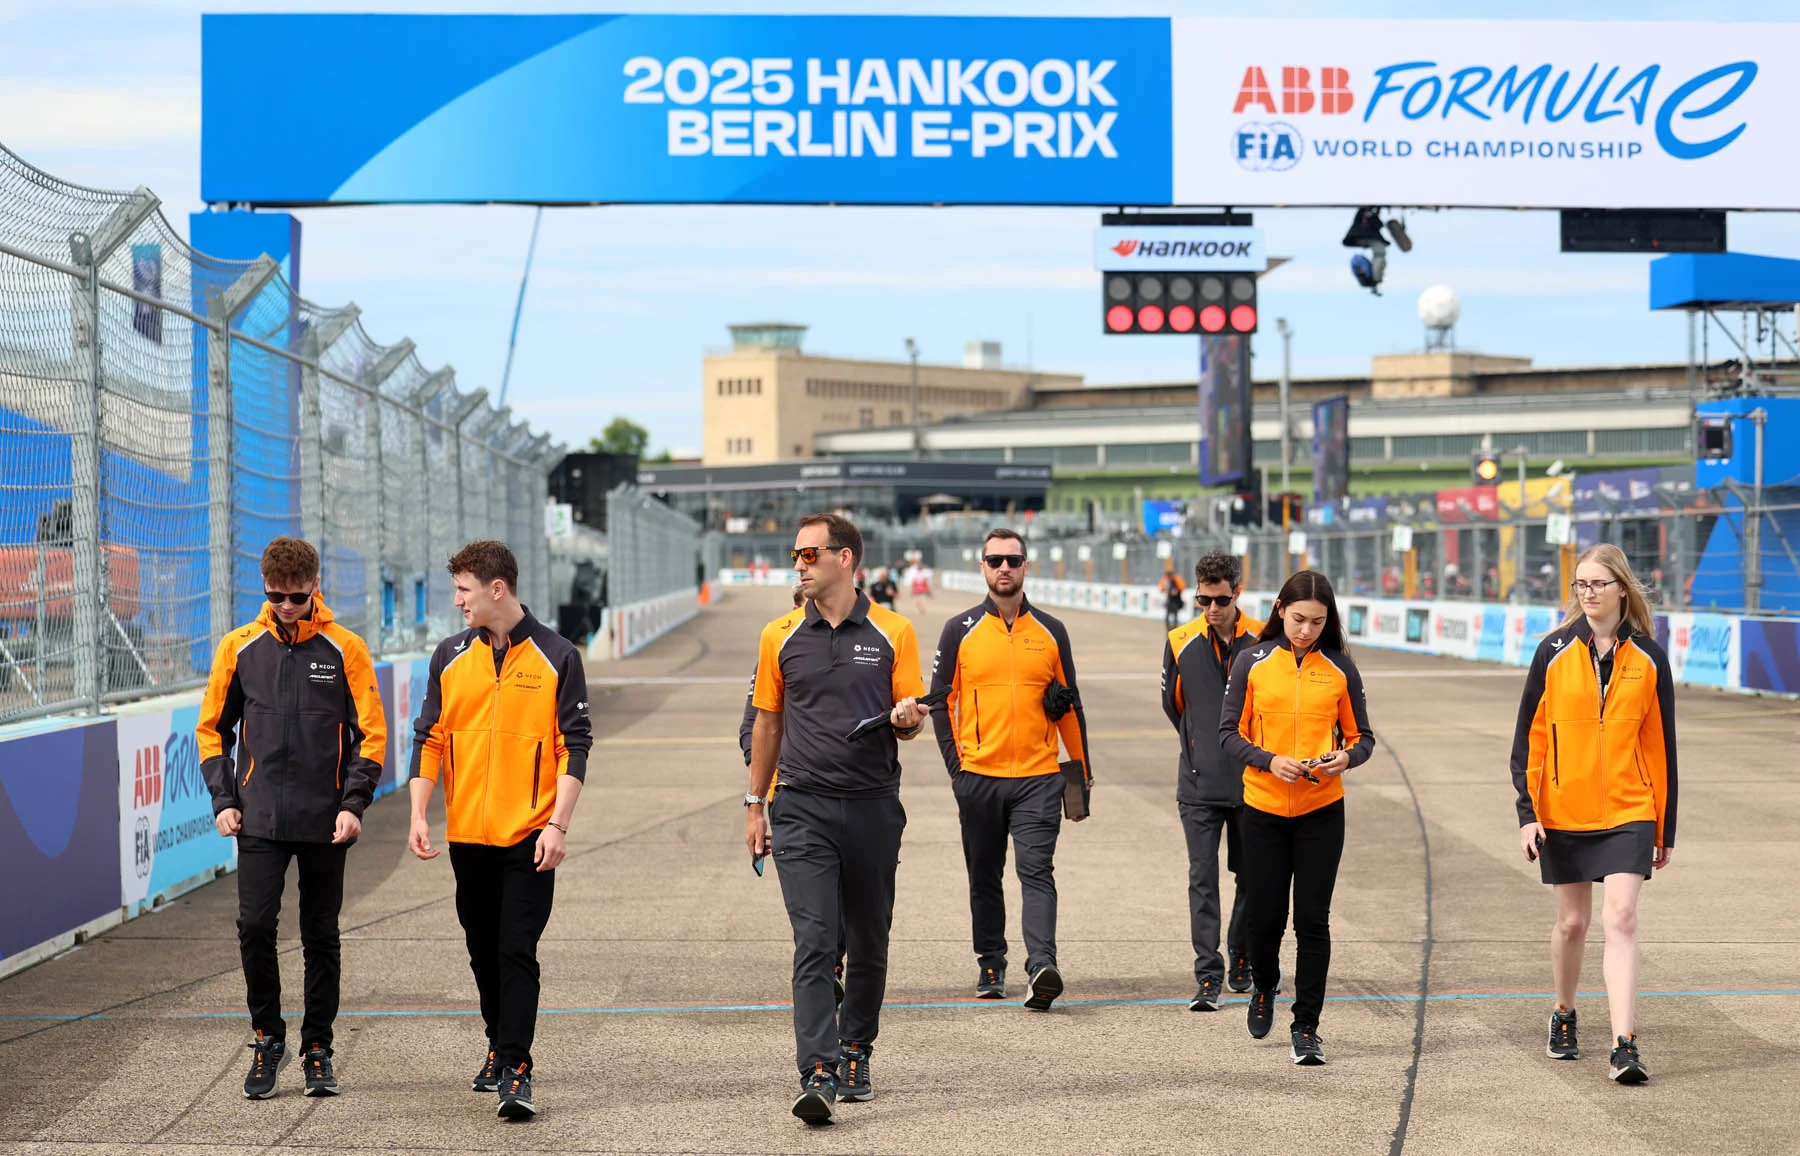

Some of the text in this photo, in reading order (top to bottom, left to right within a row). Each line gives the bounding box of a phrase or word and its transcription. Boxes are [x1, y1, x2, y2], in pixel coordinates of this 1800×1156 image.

[623, 56, 1117, 107] 2025 HANKOOK
[1233, 66, 1354, 115] ABB
[1363, 61, 1661, 125] FORMULA
[668, 109, 1118, 158] BERLIN E-PRIX
[1313, 140, 1413, 158] WORLD
[1426, 140, 1642, 160] CHAMPIONSHIP
[134, 729, 206, 811] ABB FORM
